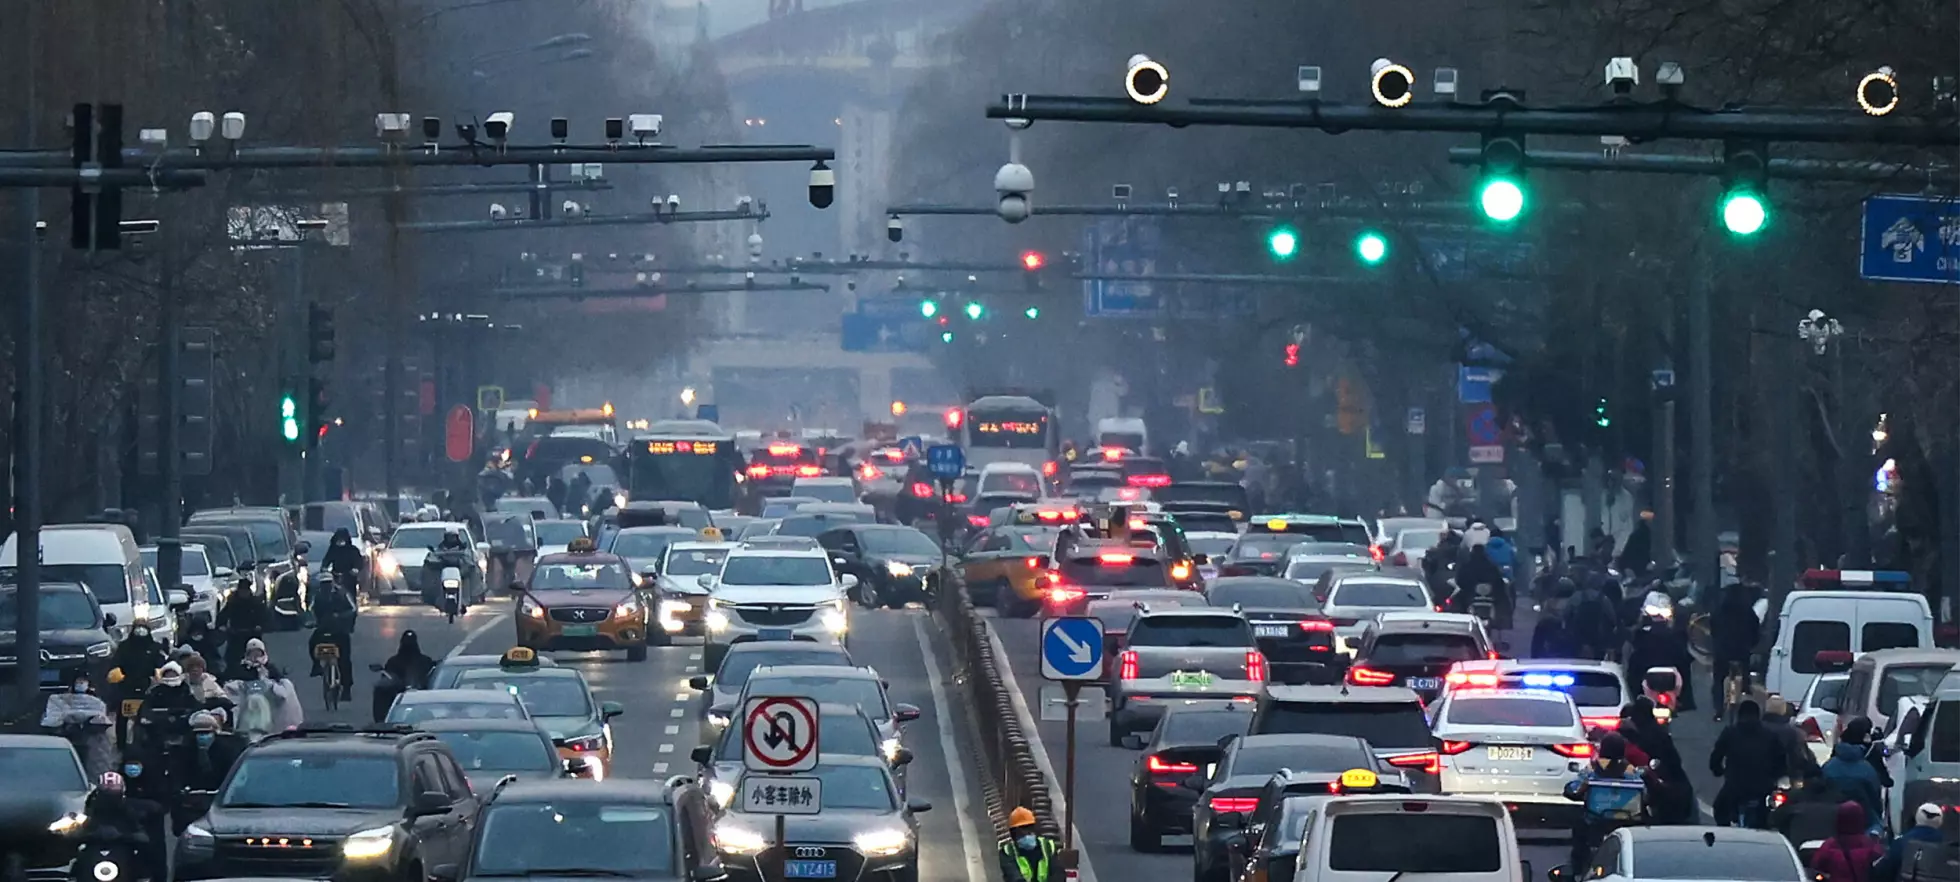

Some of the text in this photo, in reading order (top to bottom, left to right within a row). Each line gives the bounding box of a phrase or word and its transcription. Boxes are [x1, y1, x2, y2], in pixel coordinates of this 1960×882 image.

[752, 785, 812, 806] 小客车除外
